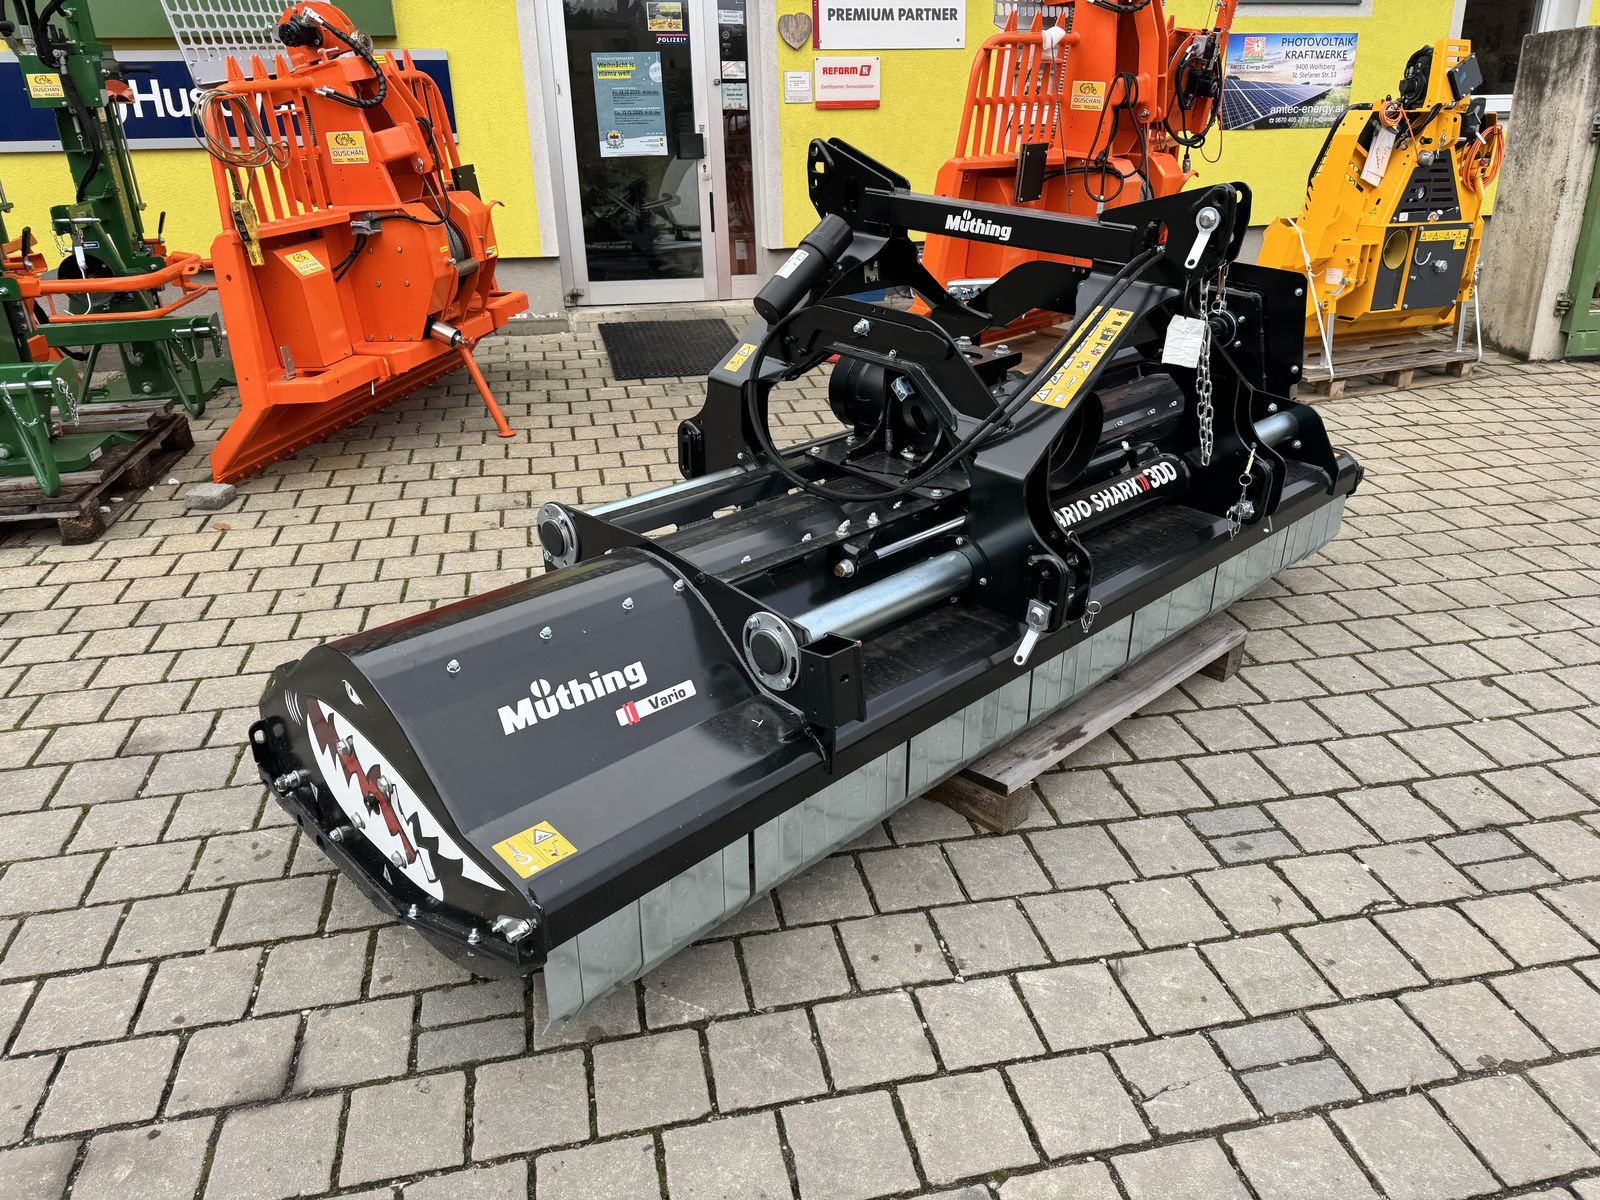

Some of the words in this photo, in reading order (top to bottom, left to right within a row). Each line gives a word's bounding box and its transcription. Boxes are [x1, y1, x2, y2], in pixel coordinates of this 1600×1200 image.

[827, 8, 895, 21] PREMIUM
[898, 8, 958, 21] PARTNER
[1281, 38, 1354, 47] PHOTOVOLTAIK
[1284, 50, 1348, 60] KRAFTWERKE
[822, 66, 858, 75] REFORM
[1052, 500, 1092, 528] ARIO
[1090, 476, 1143, 512] SHARK
[1143, 462, 1178, 488] 300
[648, 688, 686, 710] Vario
